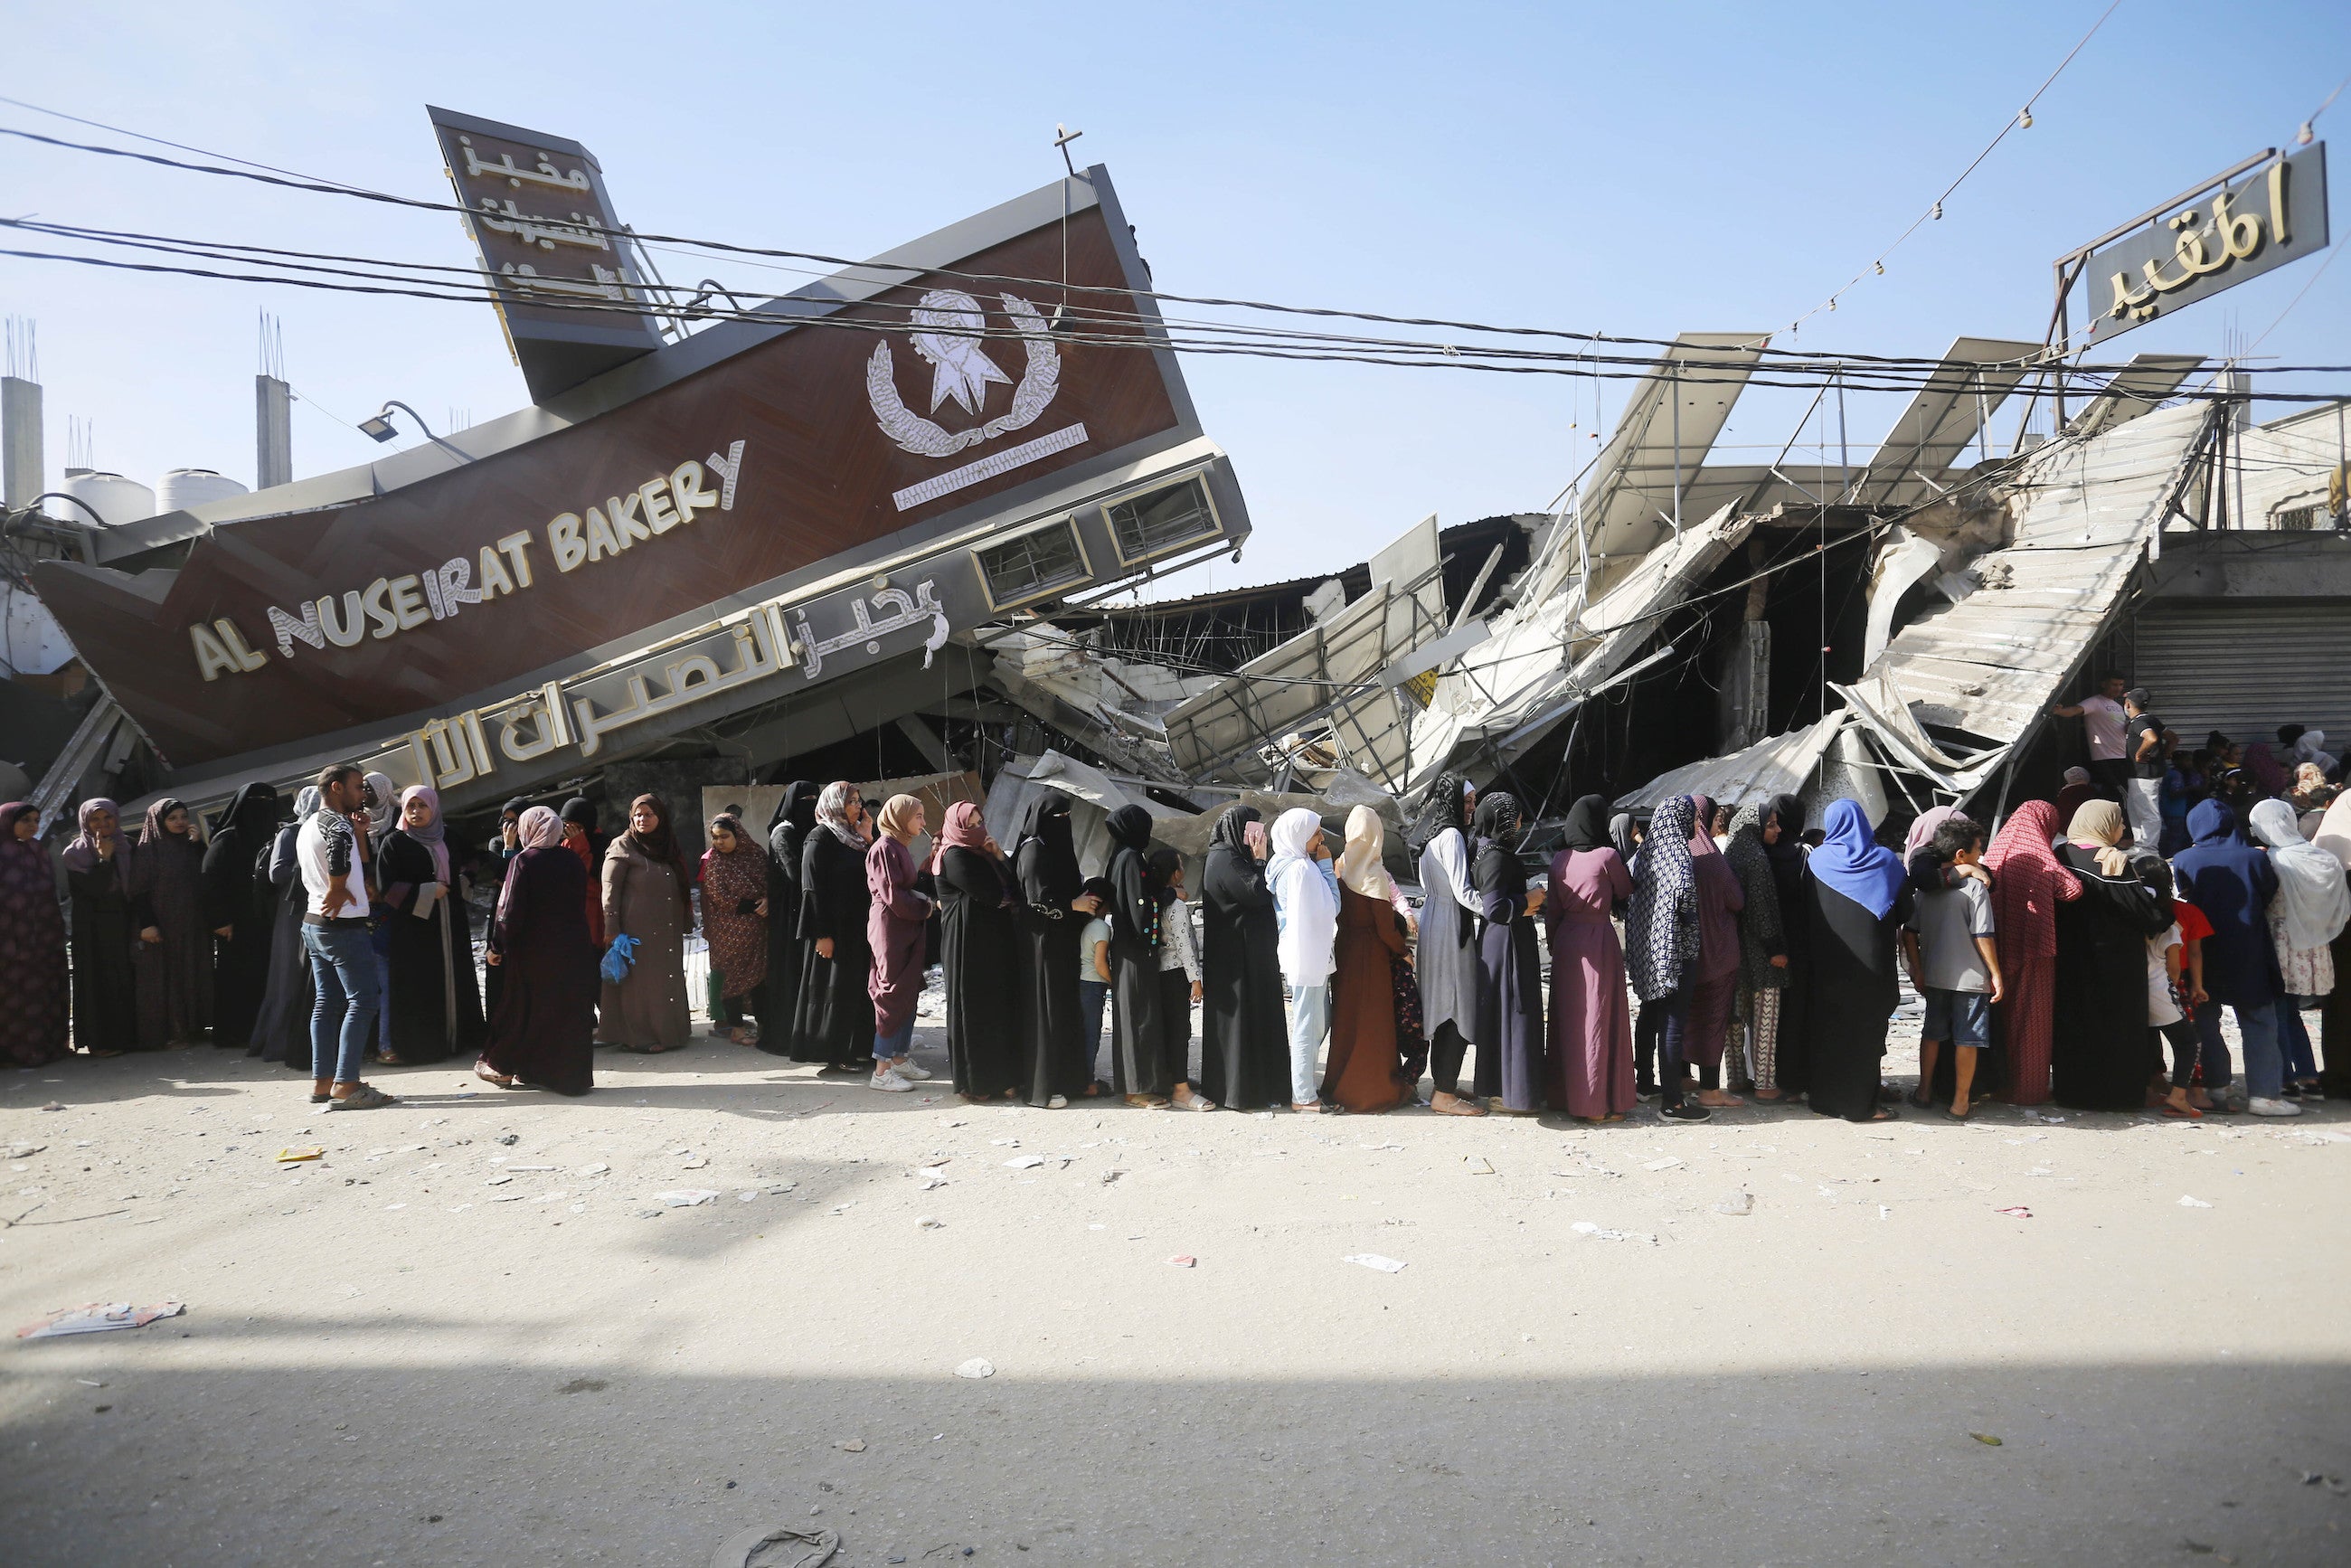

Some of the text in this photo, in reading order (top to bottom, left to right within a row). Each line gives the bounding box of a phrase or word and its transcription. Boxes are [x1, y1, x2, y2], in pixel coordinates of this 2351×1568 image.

[459, 136, 590, 192] مخبز
[189, 439, 746, 681] AL NUSEIRAT BAKERY
